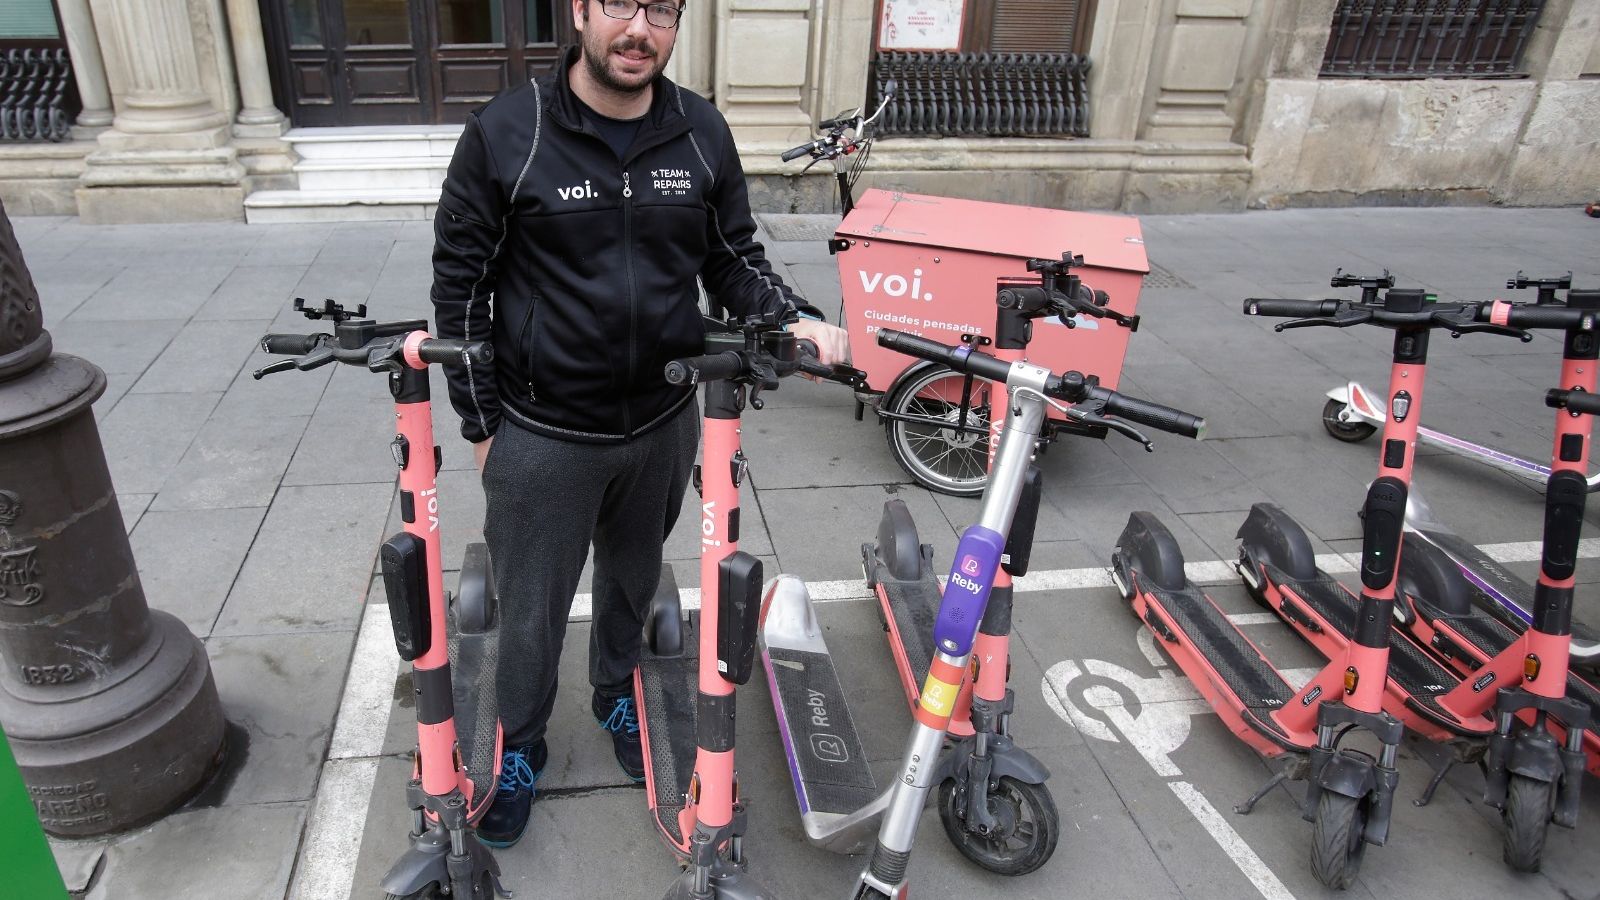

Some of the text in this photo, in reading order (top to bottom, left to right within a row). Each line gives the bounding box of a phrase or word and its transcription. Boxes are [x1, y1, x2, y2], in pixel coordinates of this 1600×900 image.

[653, 180, 691, 189] REPAIRS
[659, 169, 684, 178] TEAM
[557, 180, 599, 200] voi.
[859, 268, 933, 301] voi.
[864, 310, 982, 334] Ciudades pensadas
[952, 571, 984, 595] Reby
[808, 688, 831, 727] Reby
